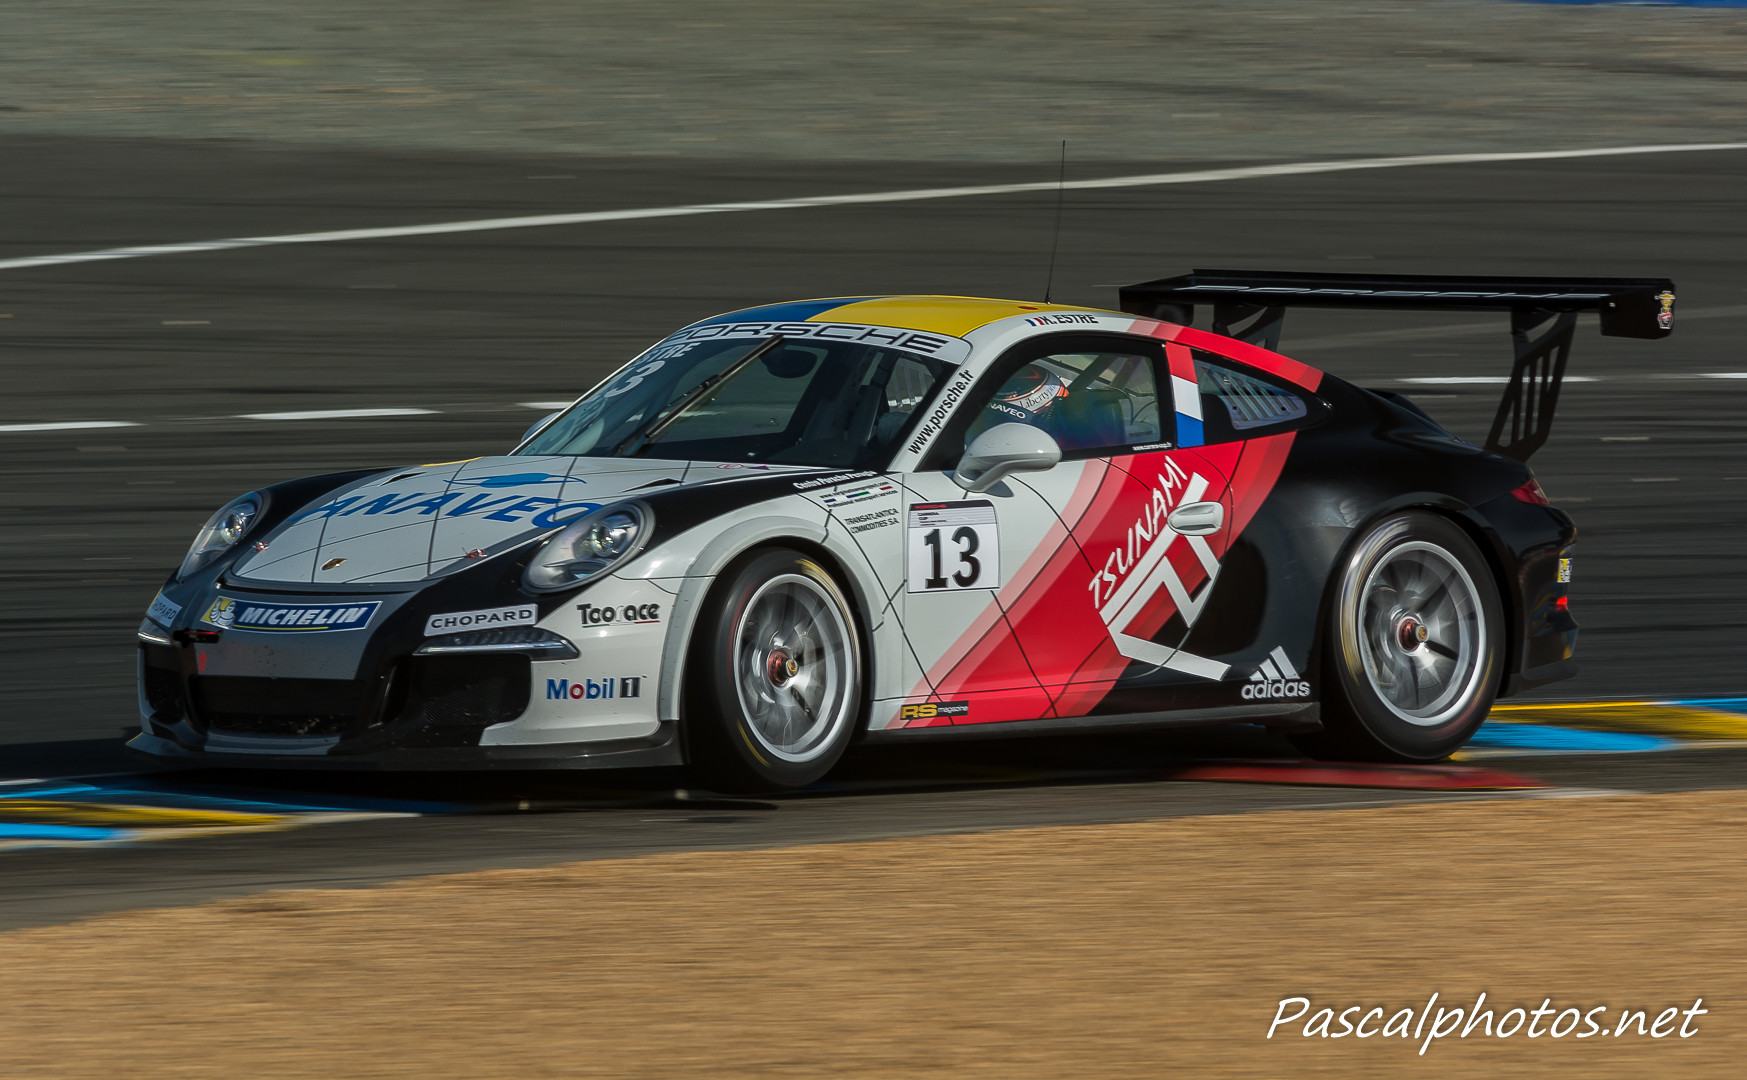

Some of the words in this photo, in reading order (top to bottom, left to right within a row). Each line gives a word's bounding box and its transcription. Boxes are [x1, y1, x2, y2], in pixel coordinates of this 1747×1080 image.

[669, 323, 950, 354] PORSCHE
[907, 369, 974, 455] www.porsche.fr
[985, 402, 1026, 419] NAVEO
[286, 492, 605, 529] ANAVEO
[1088, 455, 1188, 610] TSUNAMI
[924, 526, 981, 590] 13
[237, 606, 369, 626] MICHELIN
[430, 609, 533, 629] CHOPARD
[546, 677, 615, 700] Mobil
[1241, 679, 1311, 700] adidas
[901, 703, 938, 719] RS
